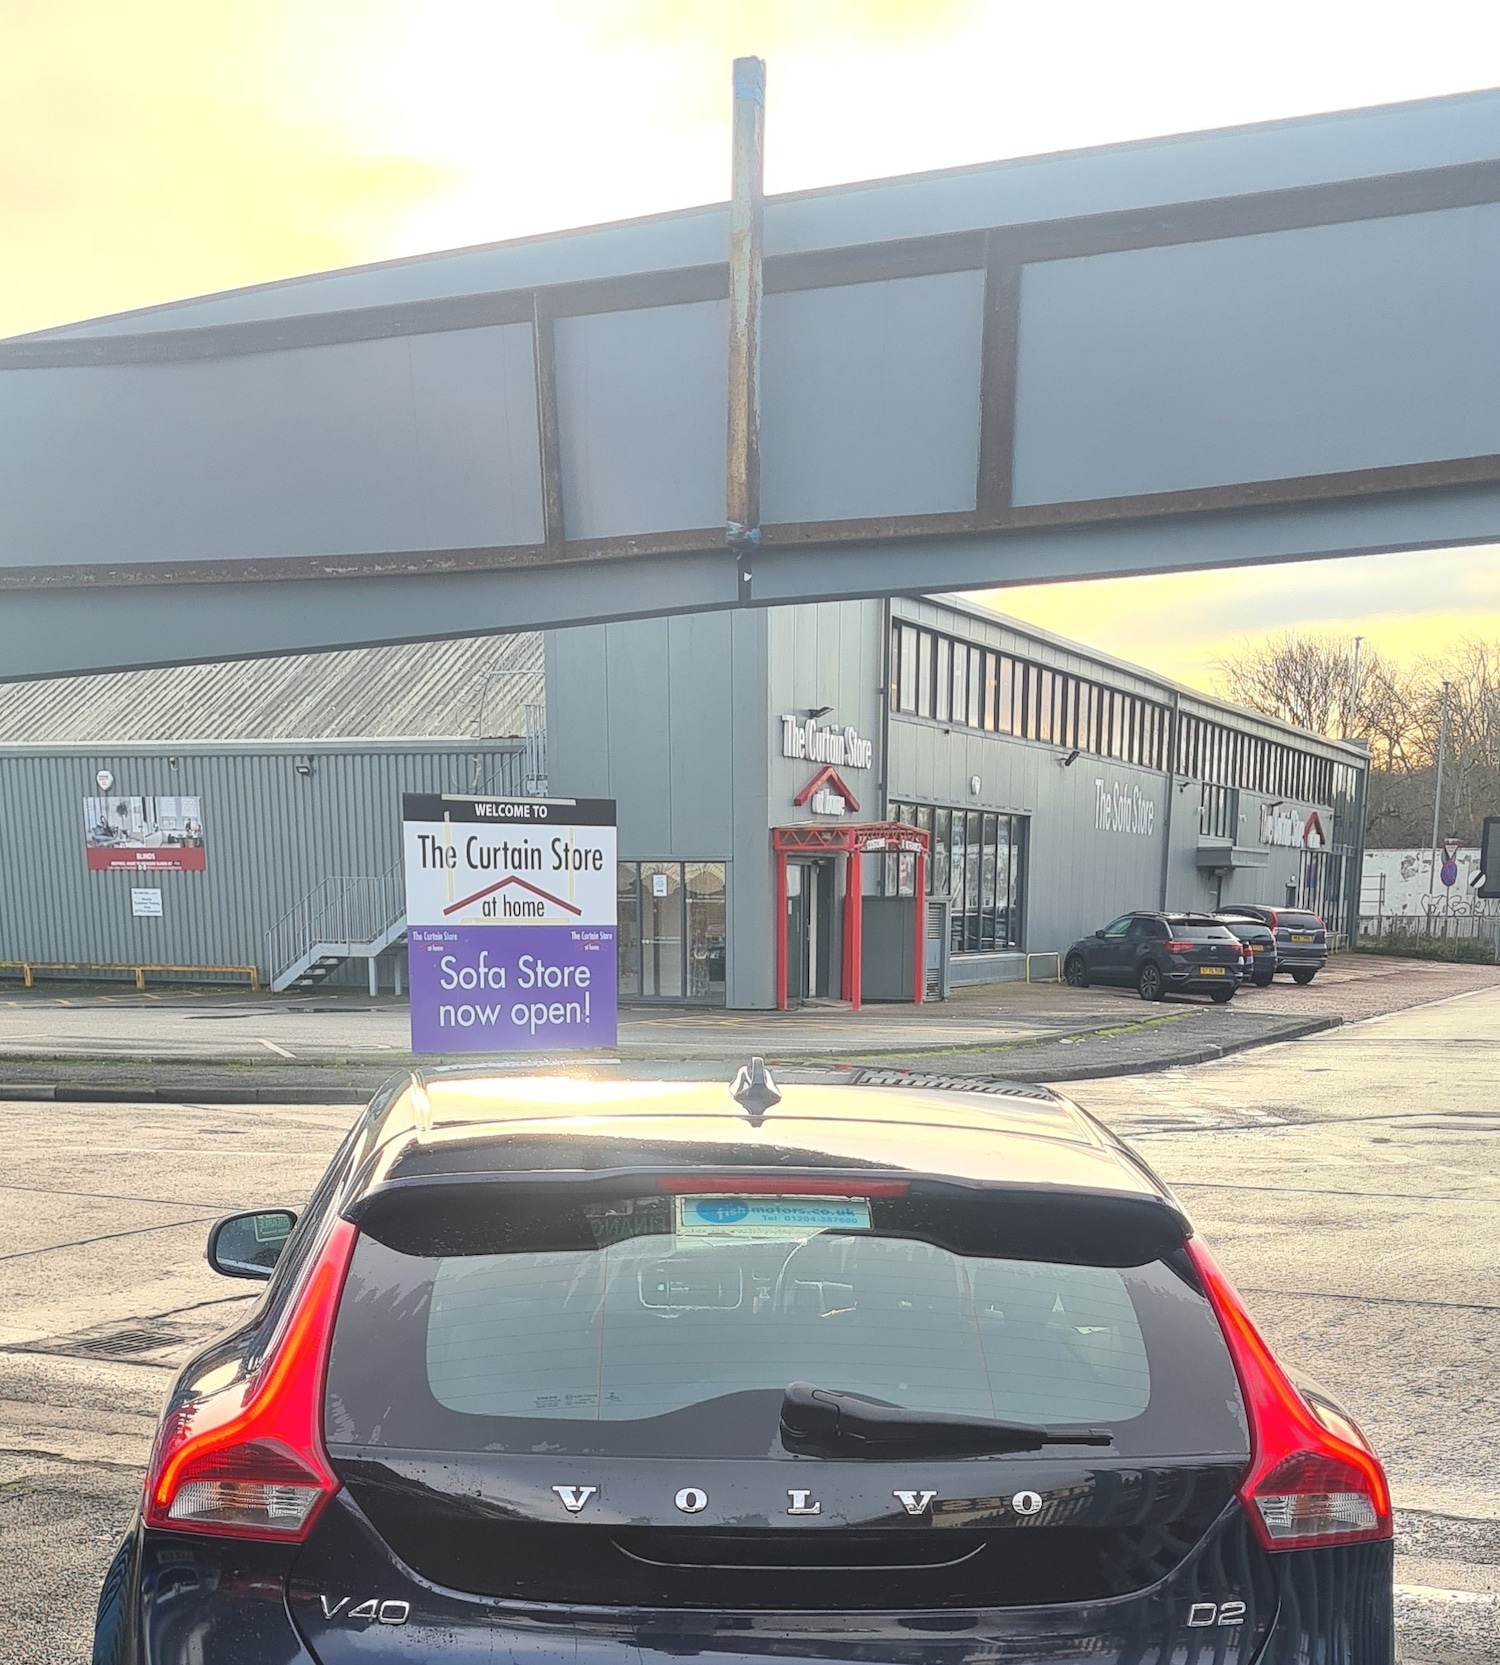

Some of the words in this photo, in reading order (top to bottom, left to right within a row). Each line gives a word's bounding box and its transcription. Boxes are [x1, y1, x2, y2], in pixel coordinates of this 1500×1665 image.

[782, 715, 805, 759] The
[804, 719, 845, 766] Curtain
[844, 726, 872, 769] Store
[475, 803, 531, 818] WELCOME
[533, 805, 548, 818] TO
[1095, 778, 1112, 831] The
[1112, 781, 1132, 833] Sofa
[1132, 784, 1154, 836] Store
[417, 834, 457, 869] The
[466, 835, 542, 870] Curtain
[551, 837, 604, 871] Store
[482, 897, 497, 917] at
[503, 894, 545, 917] home
[412, 931, 423, 941] The
[423, 931, 443, 941] Curtain
[443, 931, 458, 941] Store
[571, 931, 581, 940] The
[581, 931, 599, 940] Curtain
[599, 931, 613, 940] Store
[440, 950, 506, 990] Sofa
[517, 954, 591, 989] Store
[439, 1004, 502, 1027] now
[510, 991, 591, 1035] open!
[716, 1204, 747, 1220] fish
[751, 1205, 856, 1217] motors.co.uk
[552, 1484, 1044, 1516] VOLVO
[320, 1594, 410, 1625] V40
[1186, 1600, 1247, 1628] D2
